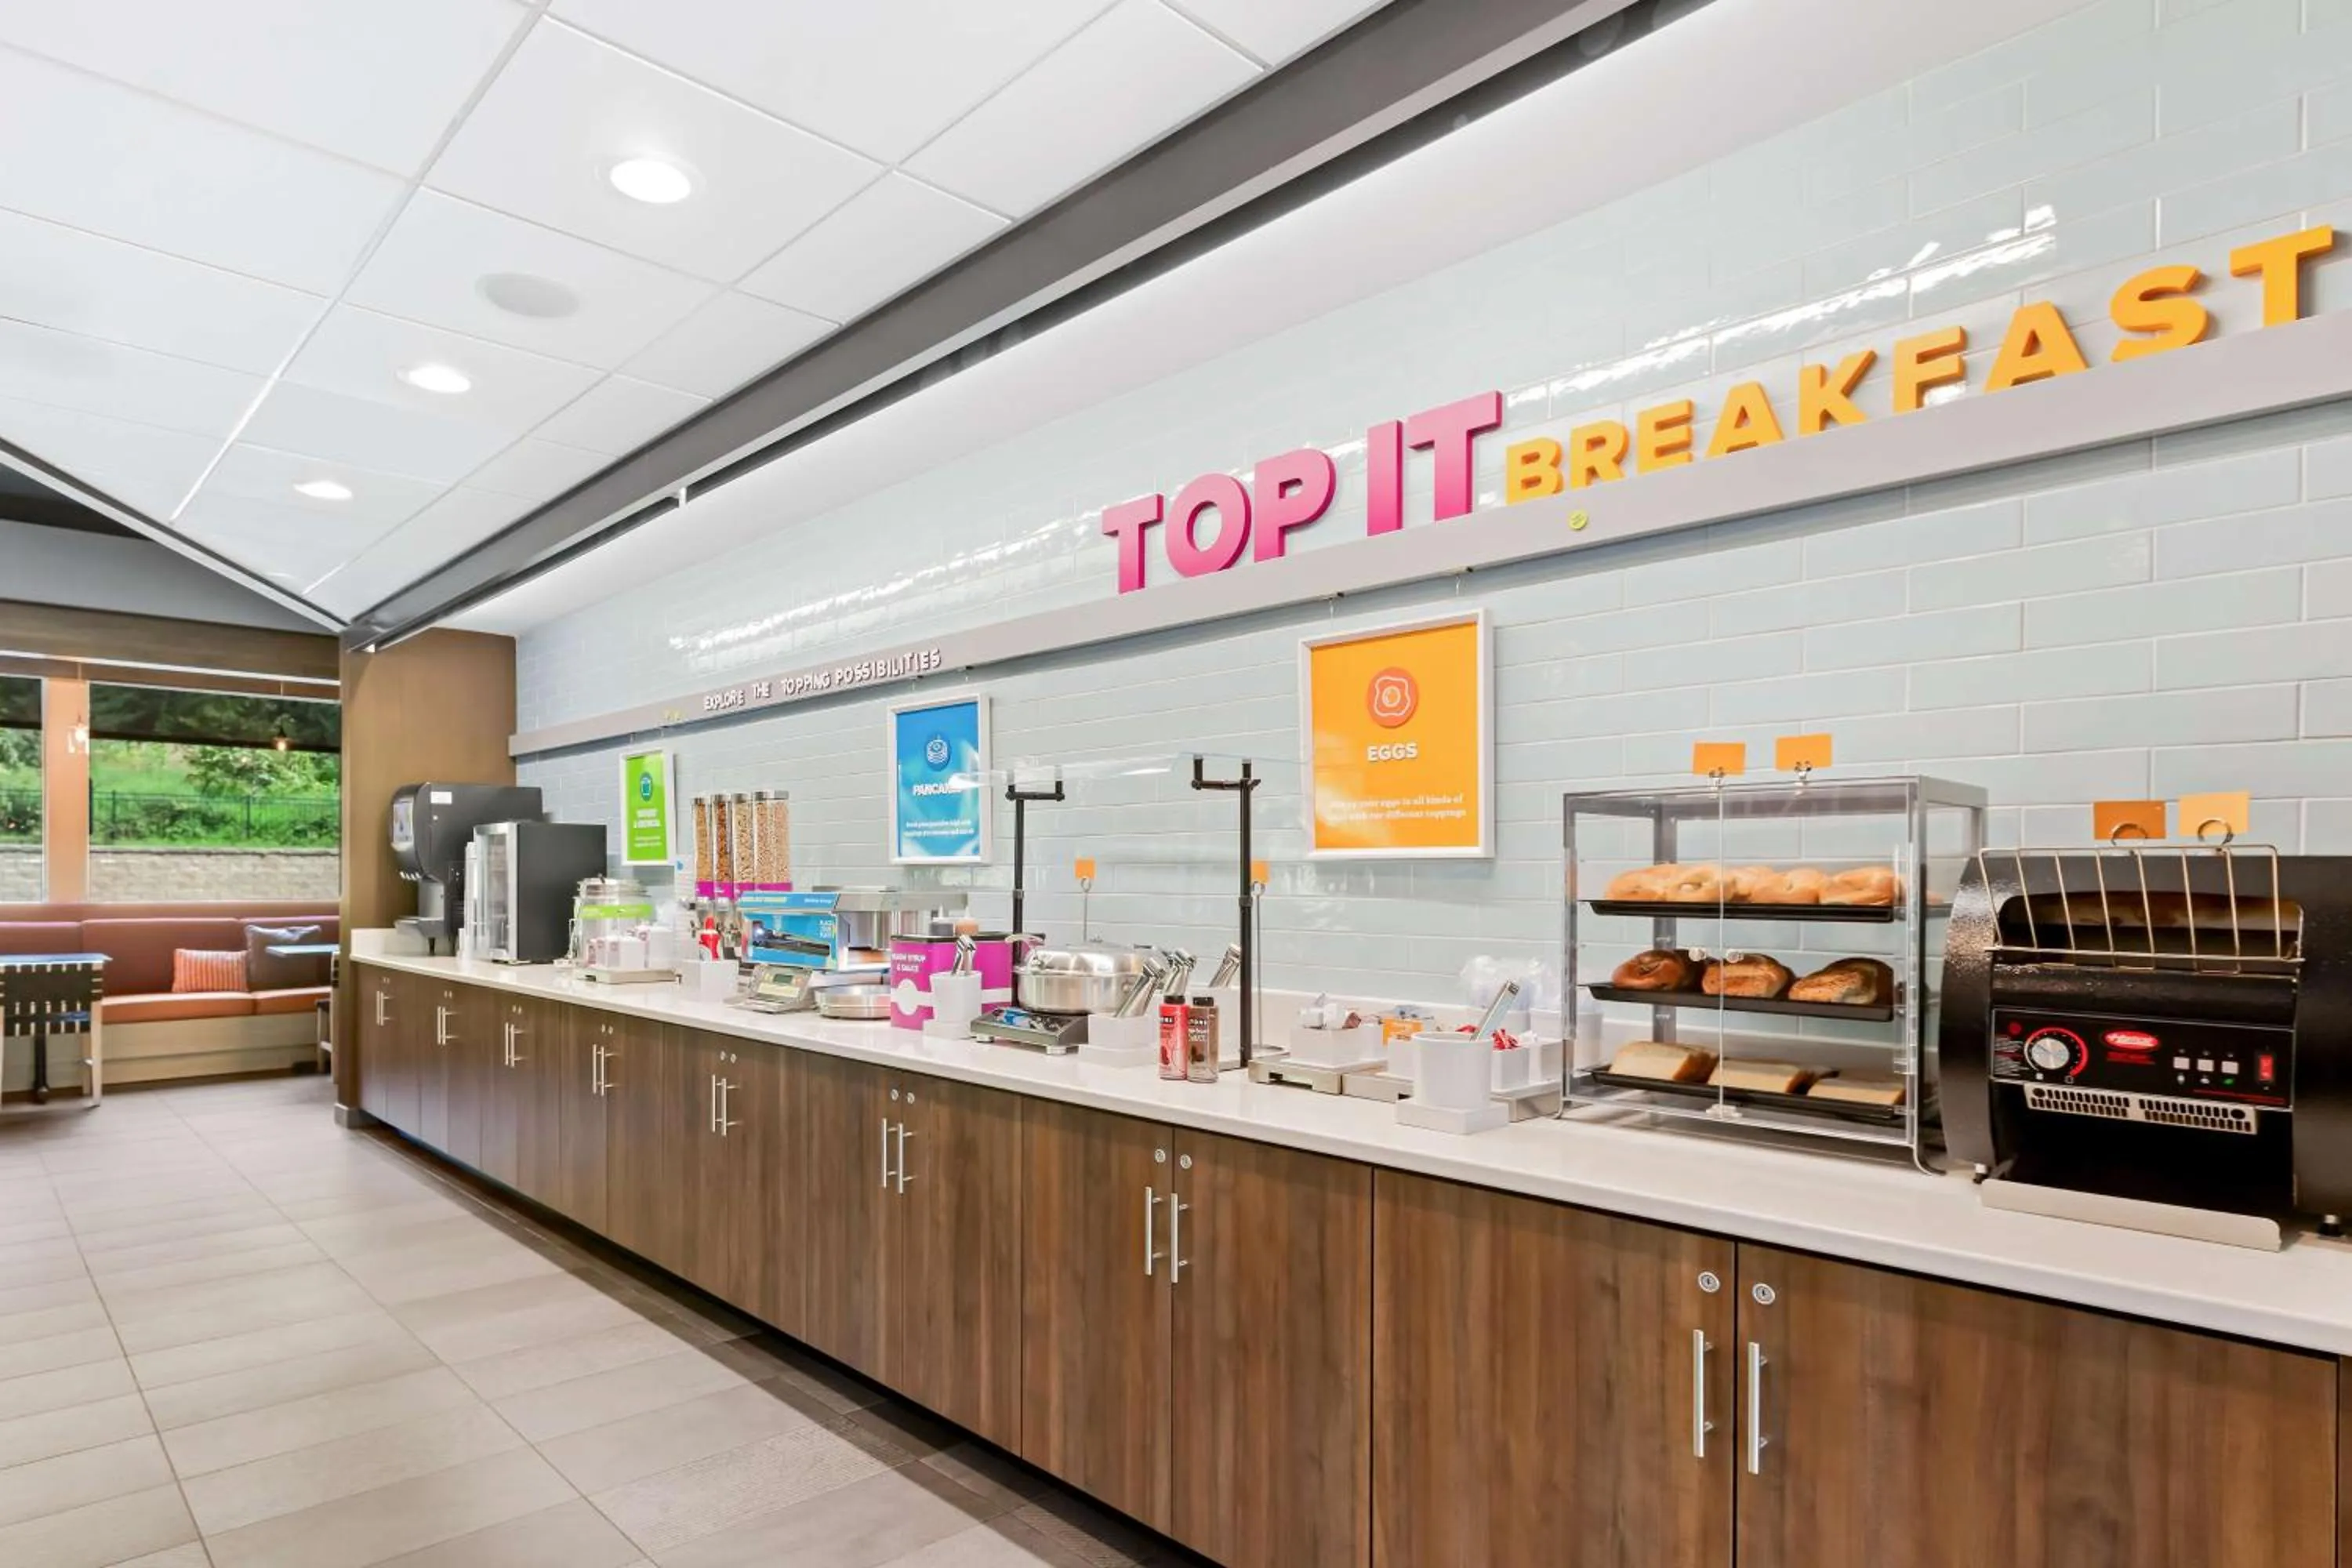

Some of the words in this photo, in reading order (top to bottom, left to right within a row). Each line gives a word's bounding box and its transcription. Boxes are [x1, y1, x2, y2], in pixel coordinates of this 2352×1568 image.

[1102, 448, 1336, 594] TOP
[1366, 390, 1502, 537] IT
[1505, 224, 2334, 504] BREAKFAST
[705, 690, 745, 710] EXPLORE
[753, 681, 771, 699] THE
[782, 672, 831, 695] TOPPING
[837, 648, 942, 685] POSSIBILITIES
[1367, 742, 1417, 761] EGGS
[913, 782, 961, 796] PANCA
